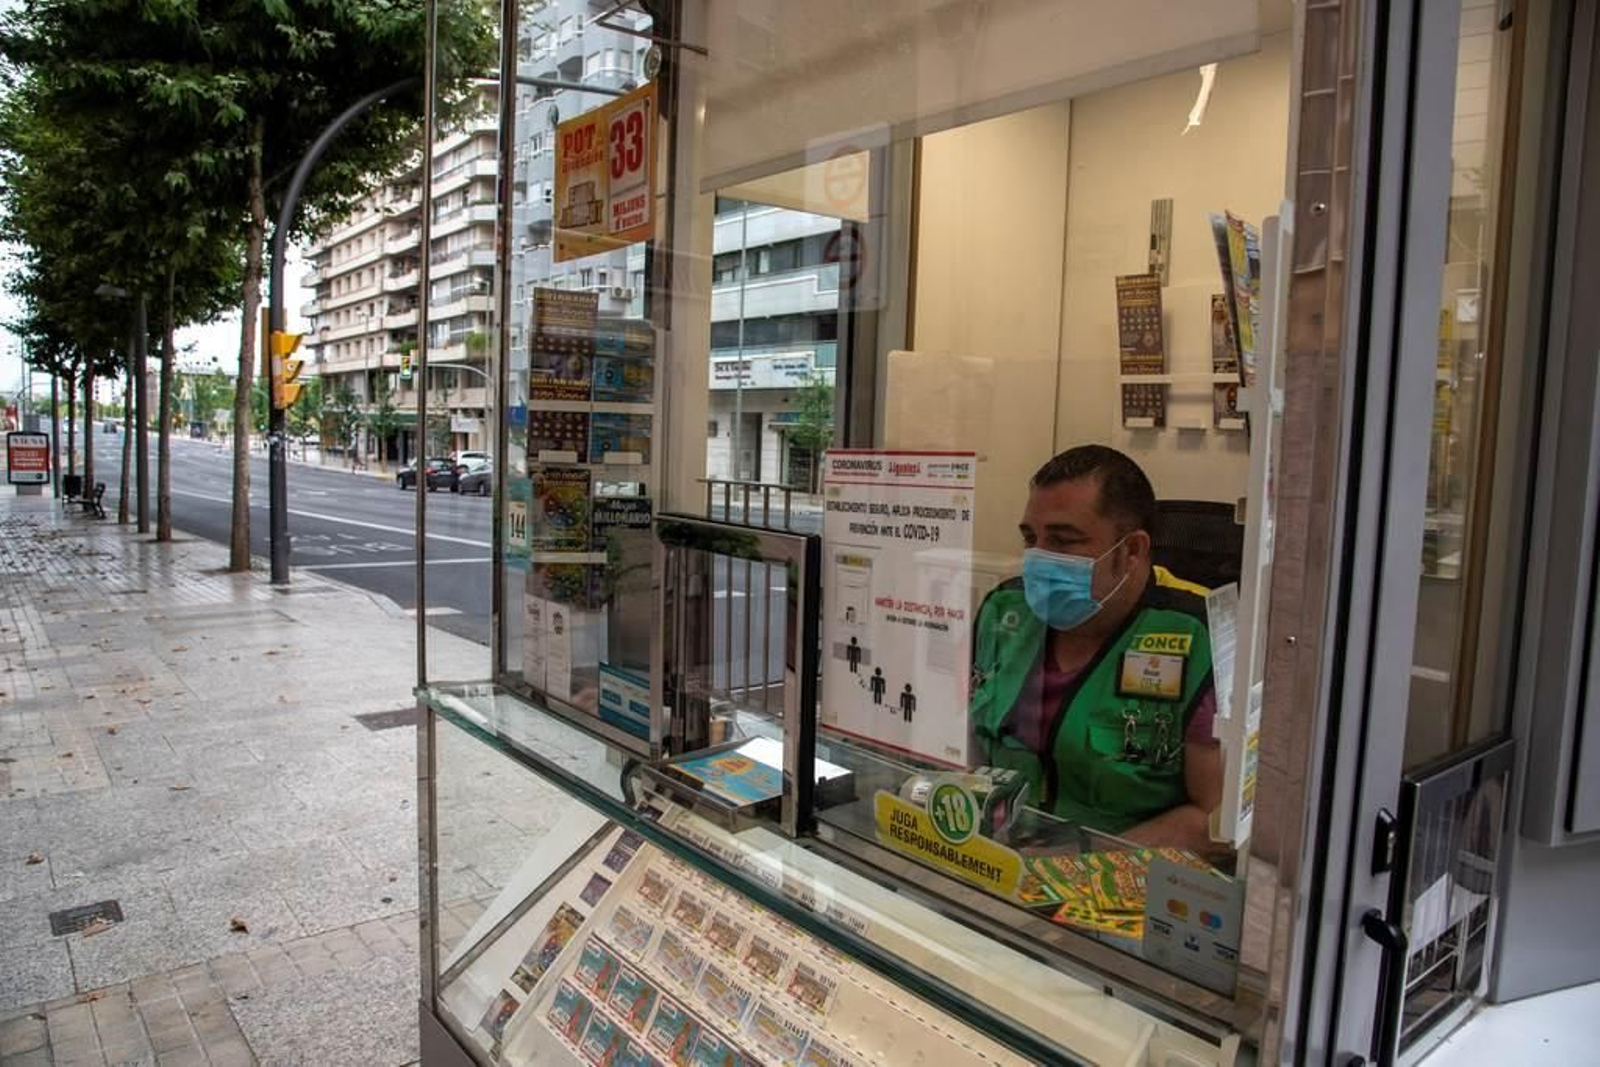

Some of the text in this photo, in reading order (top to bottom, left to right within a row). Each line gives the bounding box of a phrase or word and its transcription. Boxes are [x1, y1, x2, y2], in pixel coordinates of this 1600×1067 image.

[564, 123, 596, 158] POT
[610, 110, 643, 180] 33
[832, 459, 882, 471] CORONAVIRUS
[962, 509, 970, 521] DE
[903, 524, 940, 542] COVID-19
[1143, 636, 1189, 650] ONCE
[890, 808, 918, 830] JUGA
[935, 792, 971, 832] +18
[890, 823, 1002, 882] RESPONSABLEMENT
